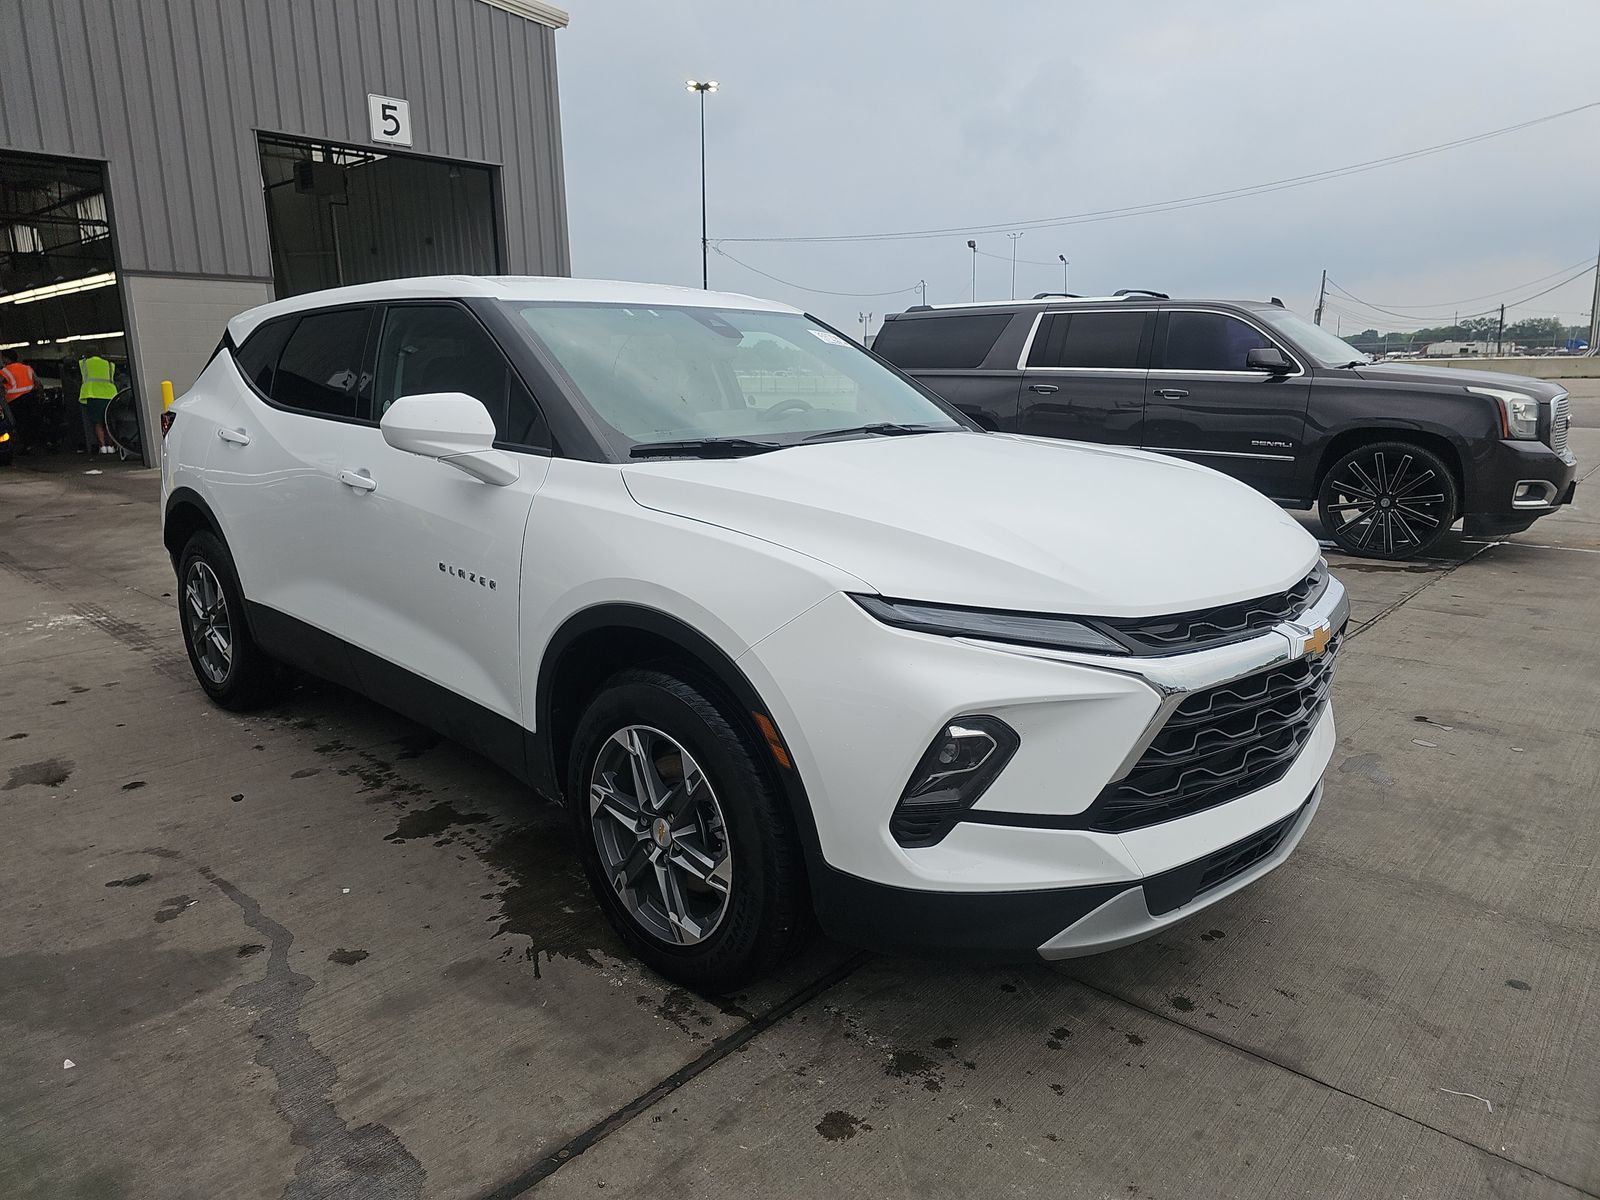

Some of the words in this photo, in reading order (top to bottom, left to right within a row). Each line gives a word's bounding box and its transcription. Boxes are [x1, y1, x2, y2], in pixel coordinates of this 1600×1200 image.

[381, 104, 401, 137] 5
[1251, 440, 1293, 448] DENALI
[438, 562, 497, 590] BLAZER
